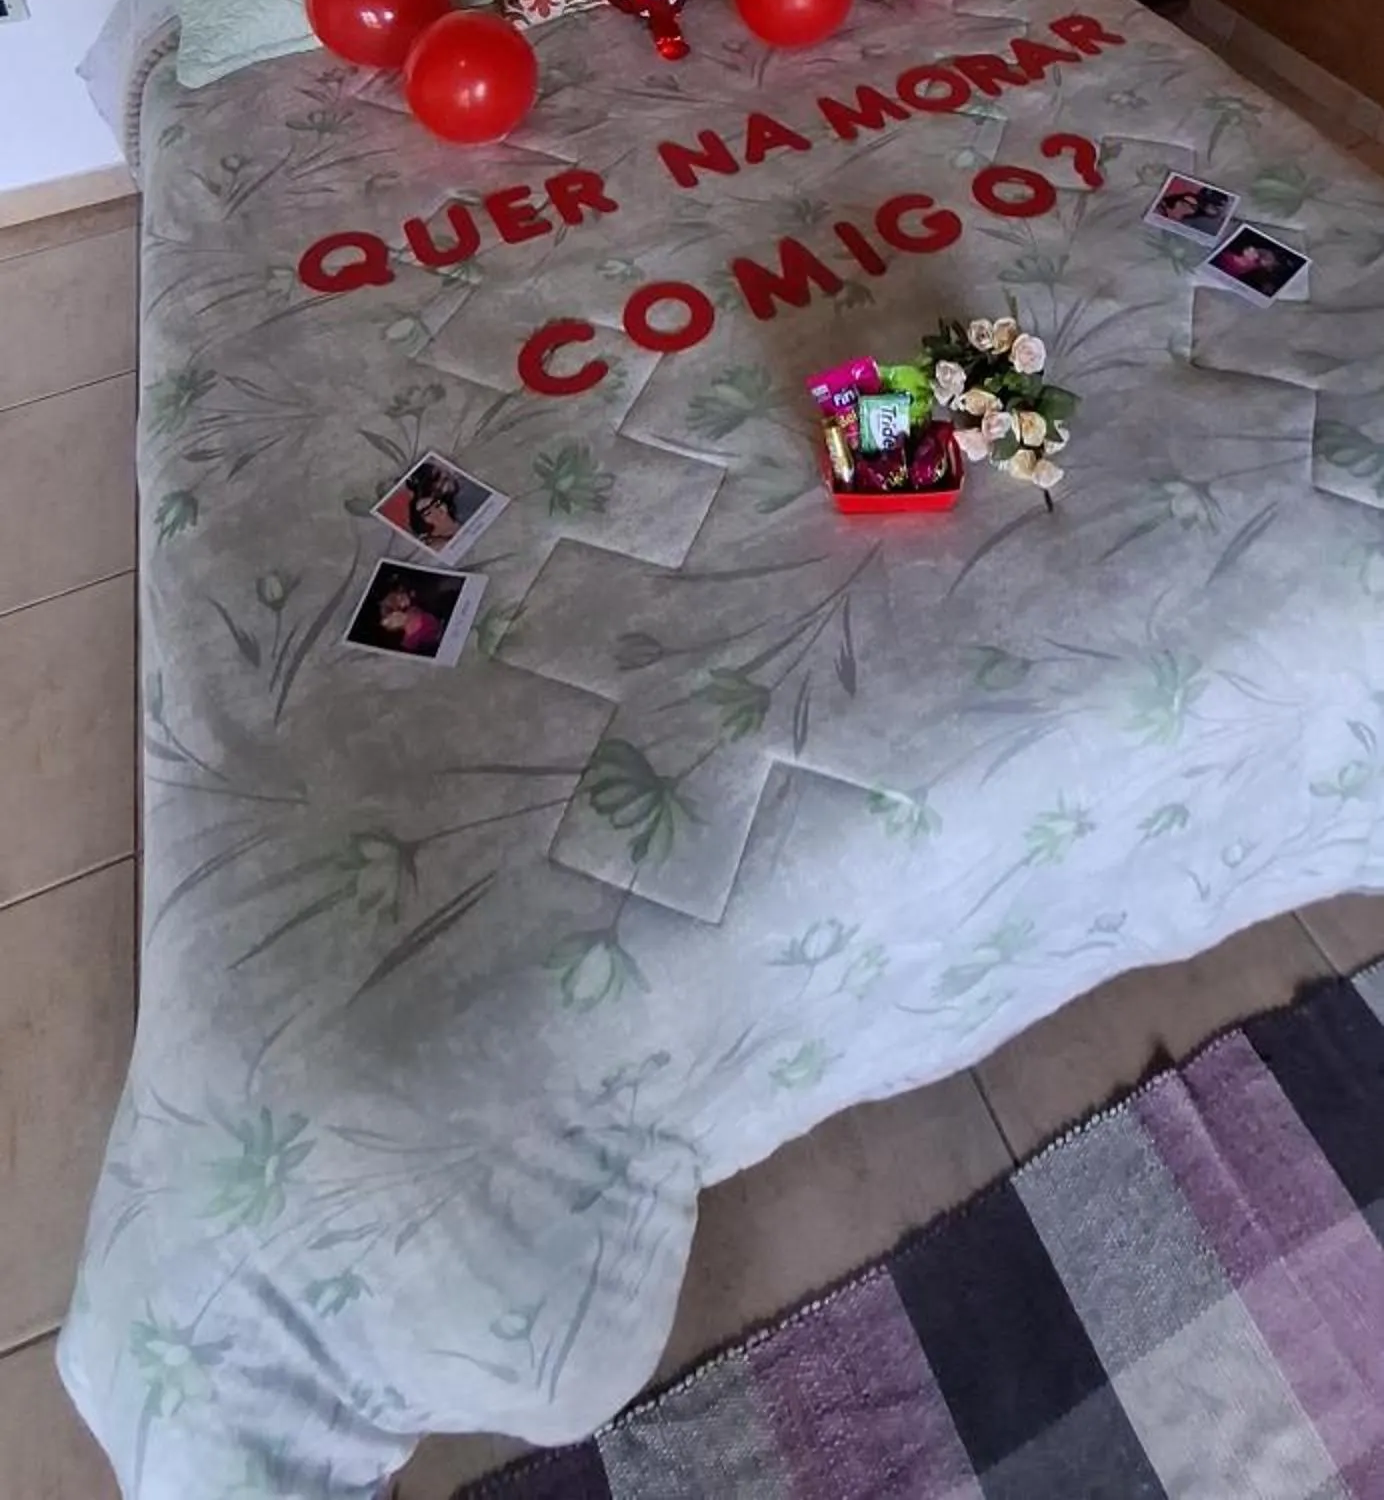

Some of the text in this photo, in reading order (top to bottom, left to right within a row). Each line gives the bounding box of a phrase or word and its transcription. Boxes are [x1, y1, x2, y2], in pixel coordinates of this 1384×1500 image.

[298, 168, 619, 294] QUER
[517, 132, 1104, 396] COMIGO?
[881, 405, 898, 450] Tride
